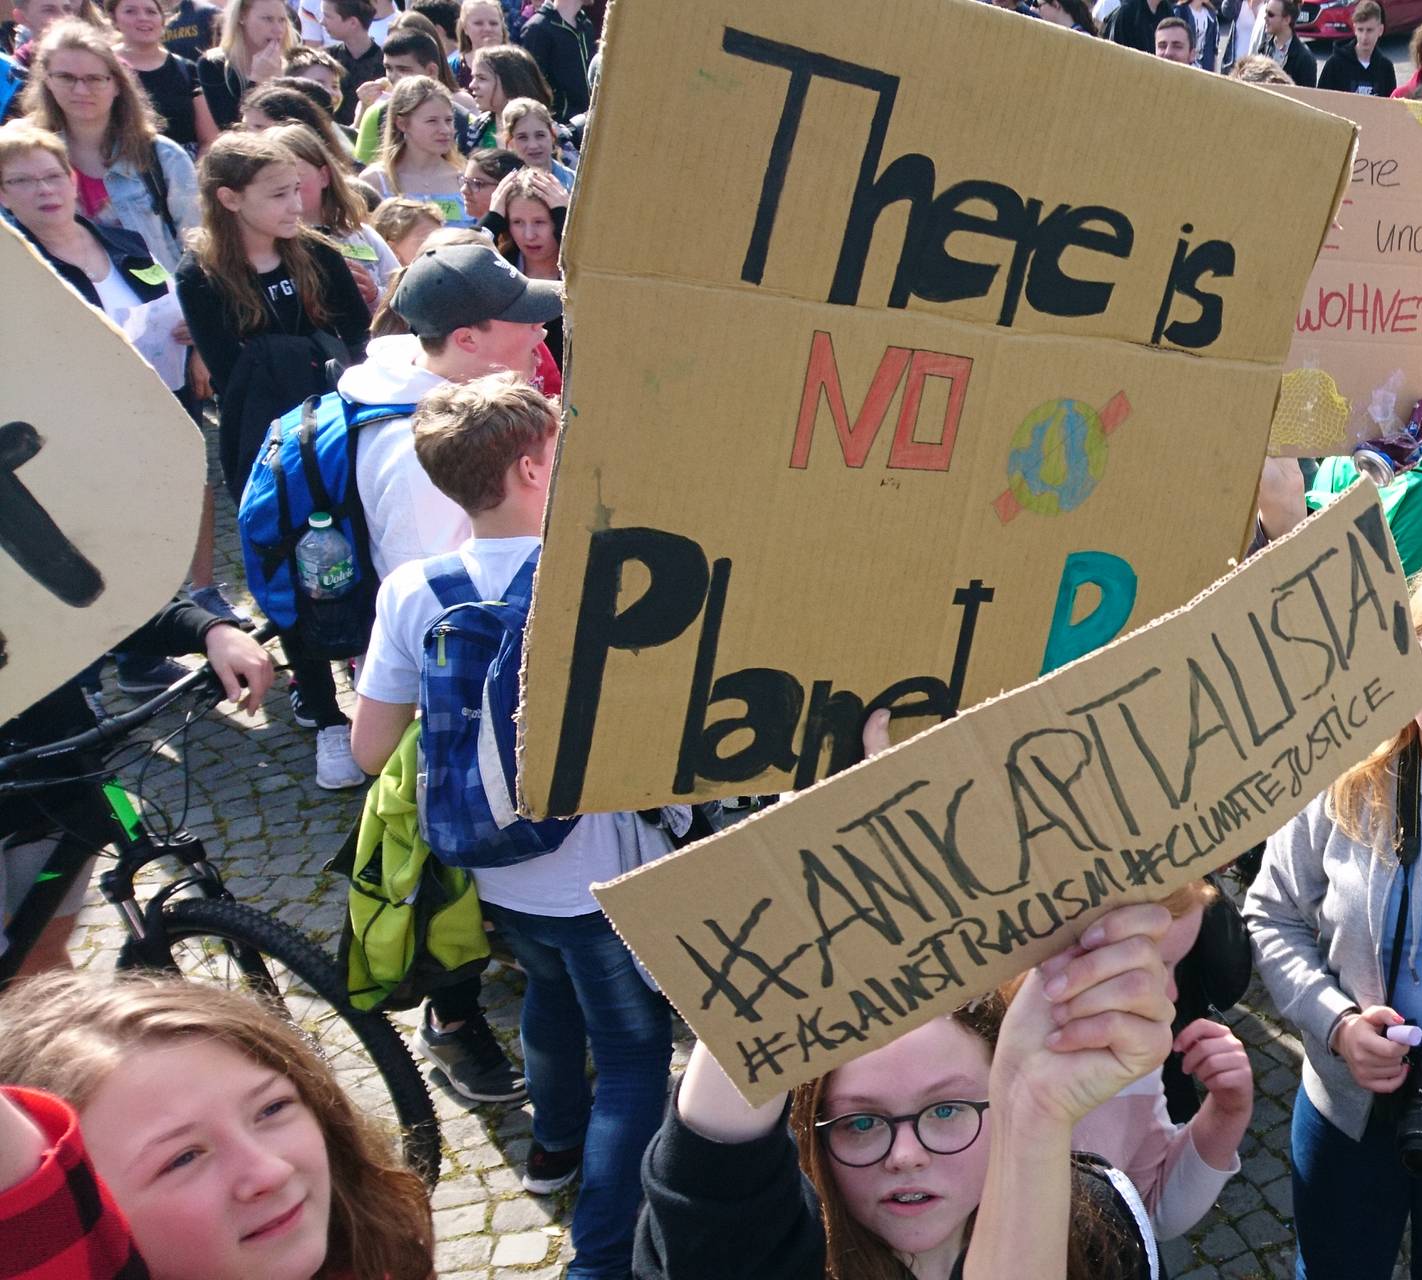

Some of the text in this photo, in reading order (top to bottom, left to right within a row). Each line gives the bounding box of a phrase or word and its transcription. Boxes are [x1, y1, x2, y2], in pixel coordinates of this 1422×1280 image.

[721, 25, 1236, 349] There is
[1351, 158, 1401, 188] ere
[788, 329, 974, 472] NO
[546, 526, 995, 818] Planet
[675, 503, 1411, 1023] #ANTICAPITALISTA!
